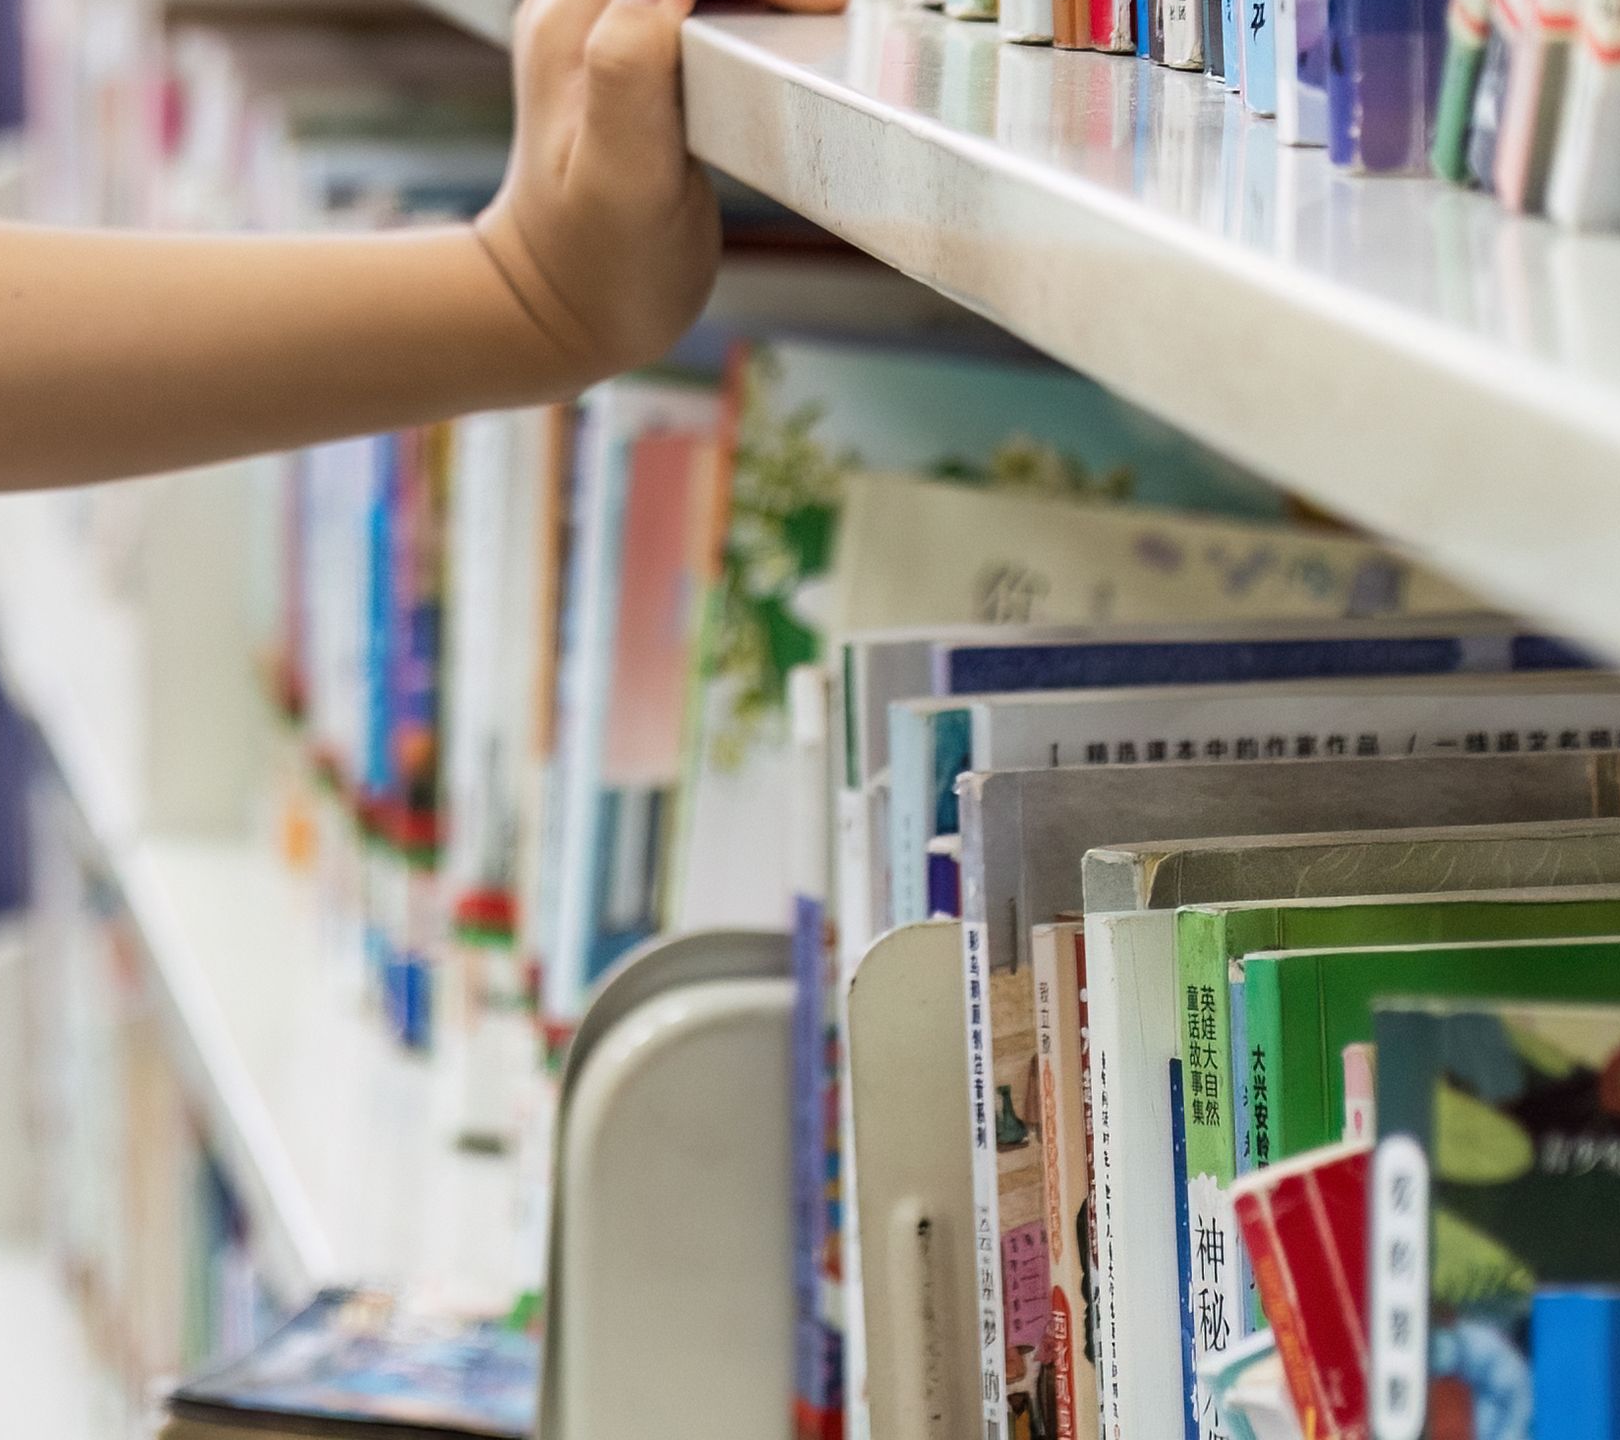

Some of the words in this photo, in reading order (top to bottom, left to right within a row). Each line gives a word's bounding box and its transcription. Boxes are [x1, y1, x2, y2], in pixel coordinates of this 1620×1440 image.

[1186, 985, 1205, 1126] 童话故事集
[1200, 984, 1221, 1128] 英娃大自然
[1252, 1043, 1270, 1169] 大兴安岭
